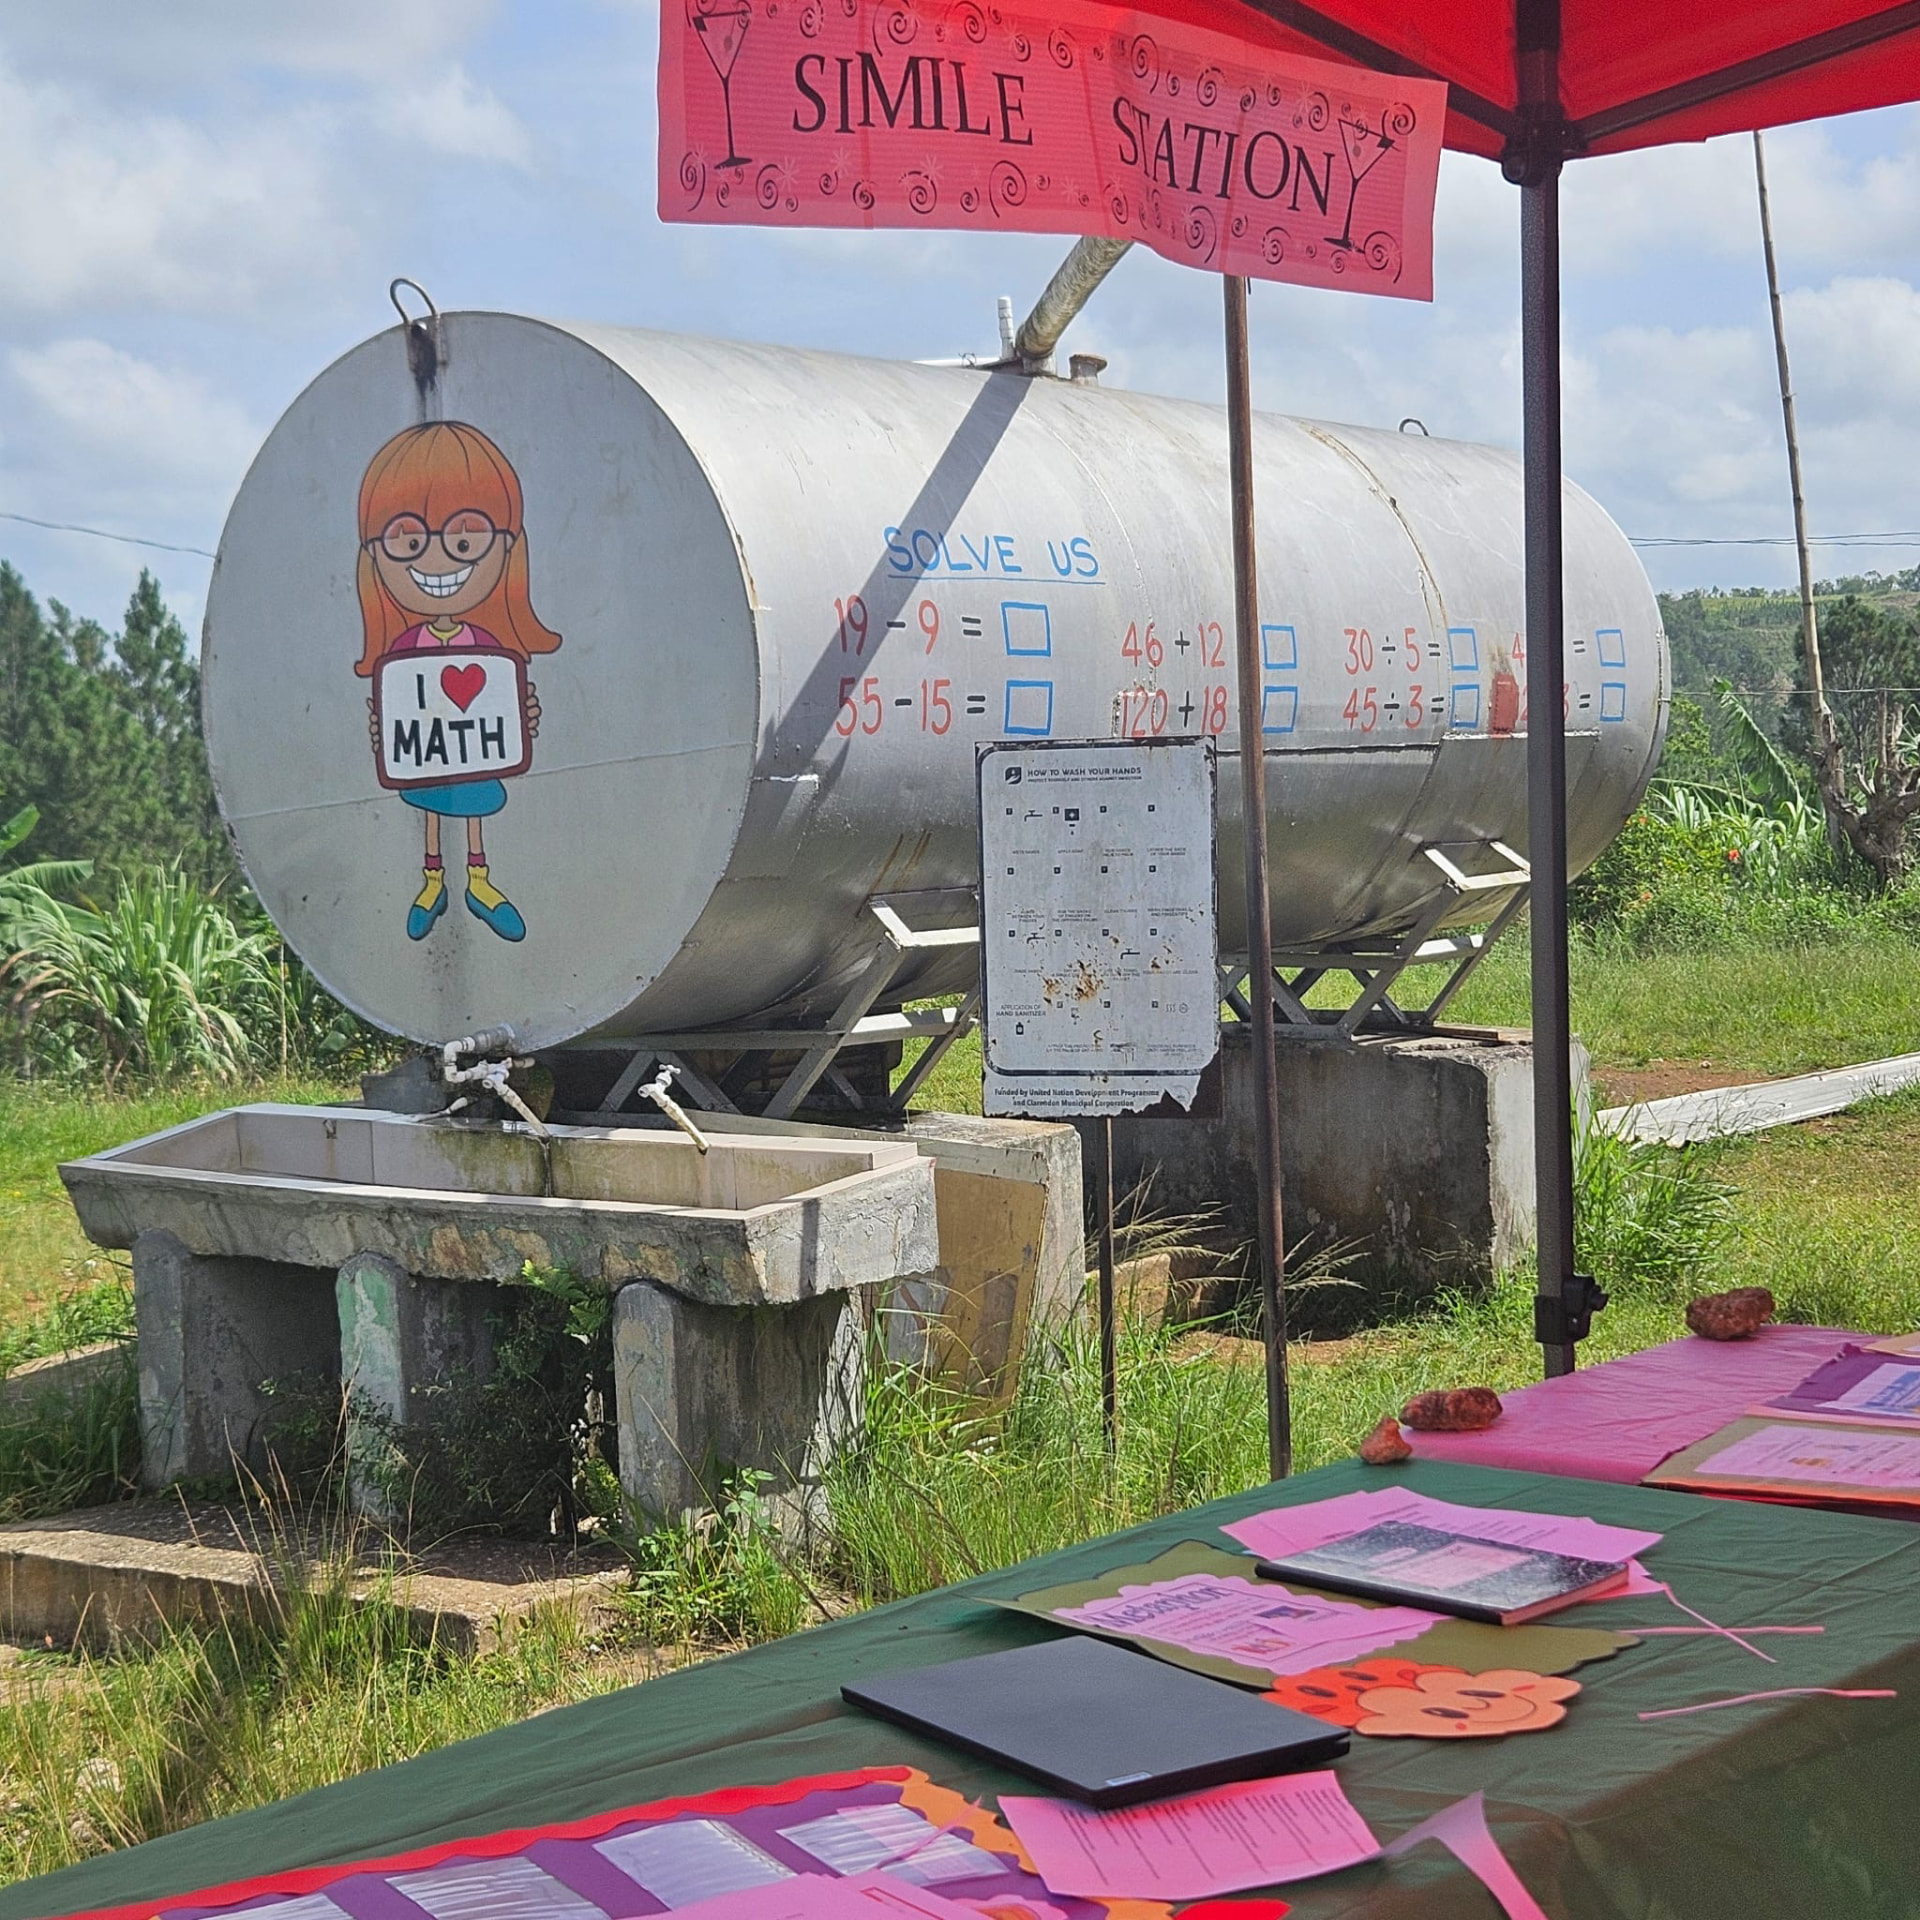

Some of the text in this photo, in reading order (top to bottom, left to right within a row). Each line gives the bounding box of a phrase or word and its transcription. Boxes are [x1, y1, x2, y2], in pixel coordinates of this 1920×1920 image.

[792, 51, 1335, 217] SIMILE STATION
[883, 526, 1100, 577] SOLVE US
[835, 595, 869, 656] 19
[918, 599, 940, 655] 9
[1121, 621, 1164, 668] 46
[1198, 621, 1226, 668] 12
[1343, 628, 1373, 675] 30
[416, 673, 426, 710] I
[835, 677, 883, 736] 55
[921, 678, 952, 736] 15
[1121, 685, 1168, 739] 120
[1201, 685, 1227, 735] 18
[1342, 687, 1377, 733] 45
[393, 716, 506, 767] MATH
[1112, 766, 1142, 774] HANDS
[1020, 1088, 1028, 1097] by
